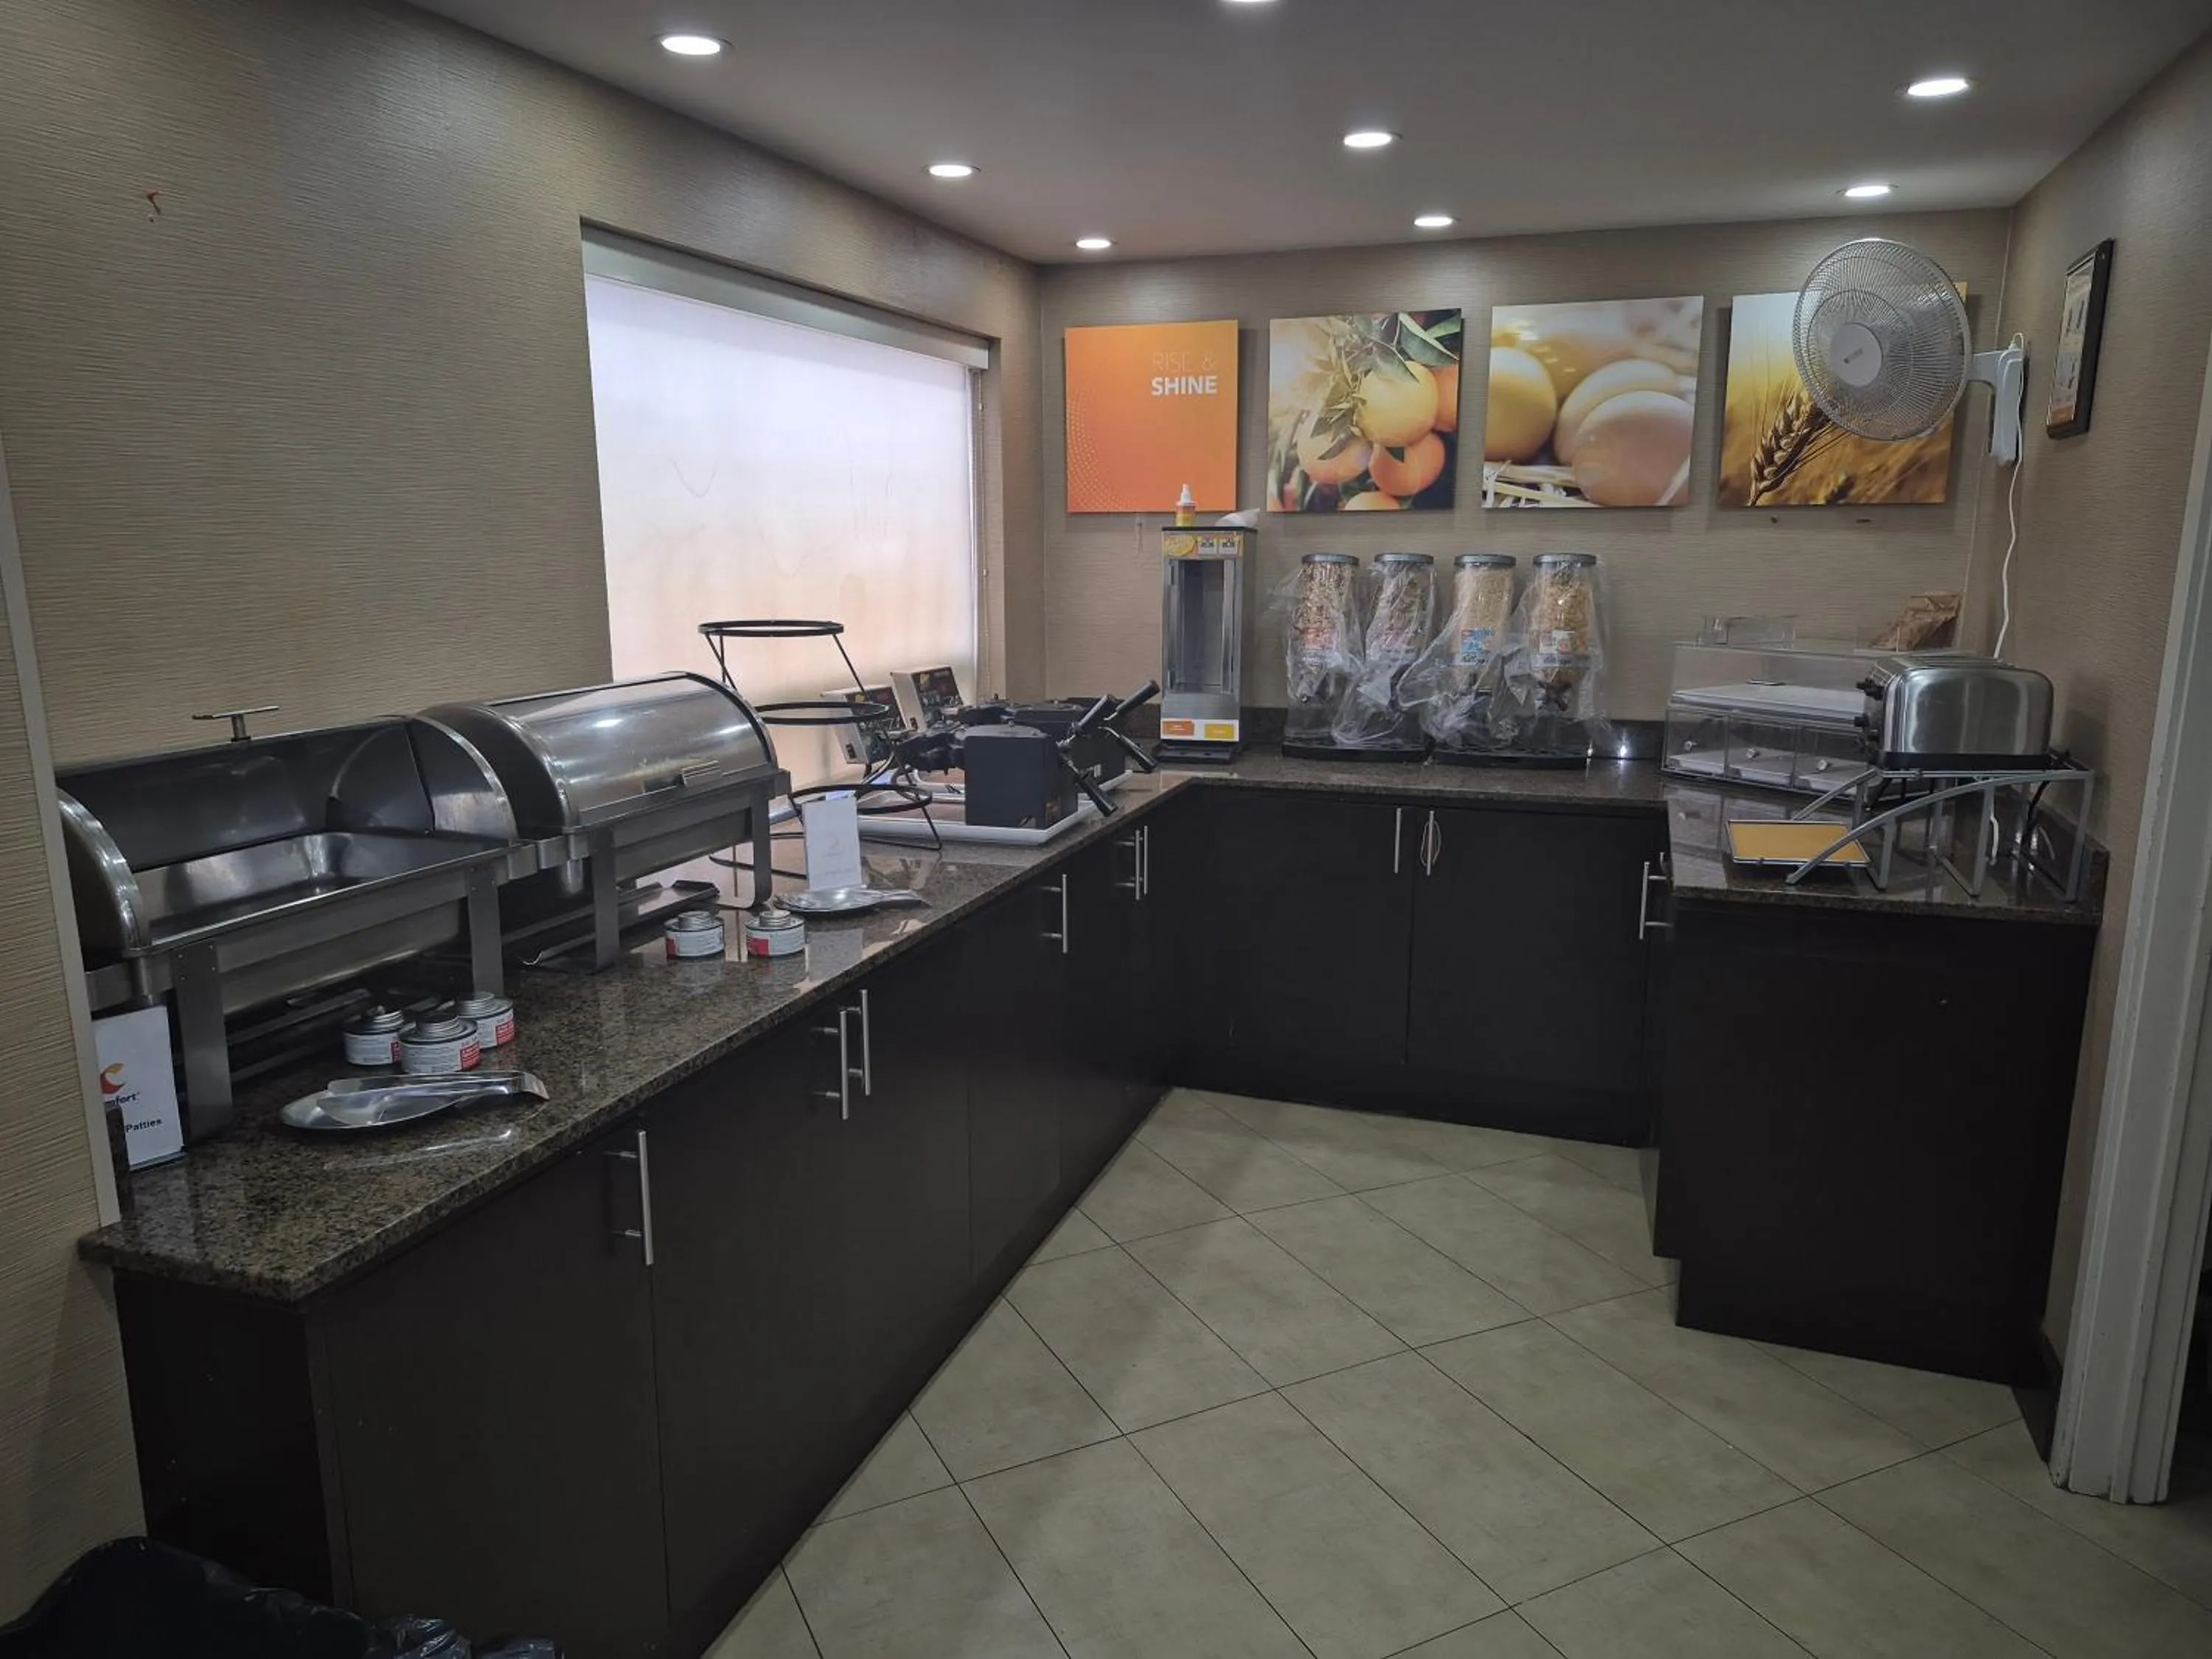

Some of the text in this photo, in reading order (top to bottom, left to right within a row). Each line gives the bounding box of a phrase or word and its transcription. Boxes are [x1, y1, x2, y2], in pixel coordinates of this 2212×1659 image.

[1152, 349, 1217, 372] RISE &
[1151, 375, 1218, 396] SHINE
[125, 1119, 161, 1133] Patties
